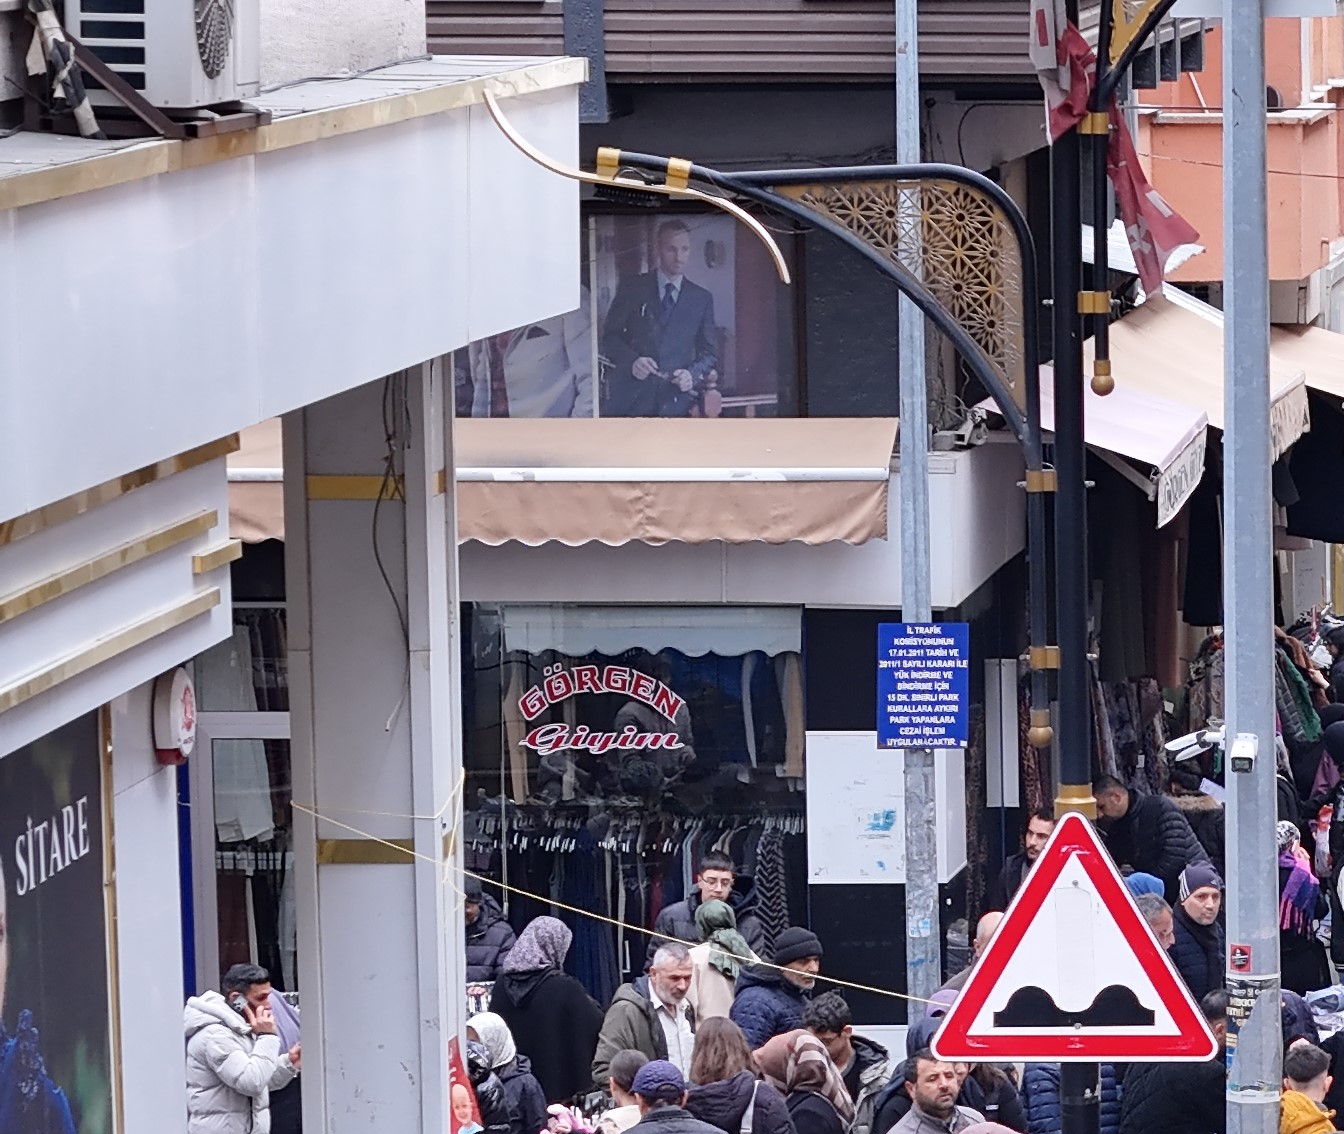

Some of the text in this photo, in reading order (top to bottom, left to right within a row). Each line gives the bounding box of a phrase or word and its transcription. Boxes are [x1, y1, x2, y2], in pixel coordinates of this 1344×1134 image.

[518, 662, 686, 724] GÖRGEN
[519, 723, 685, 755] Giyim
[15, 796, 90, 896] SİTARE
